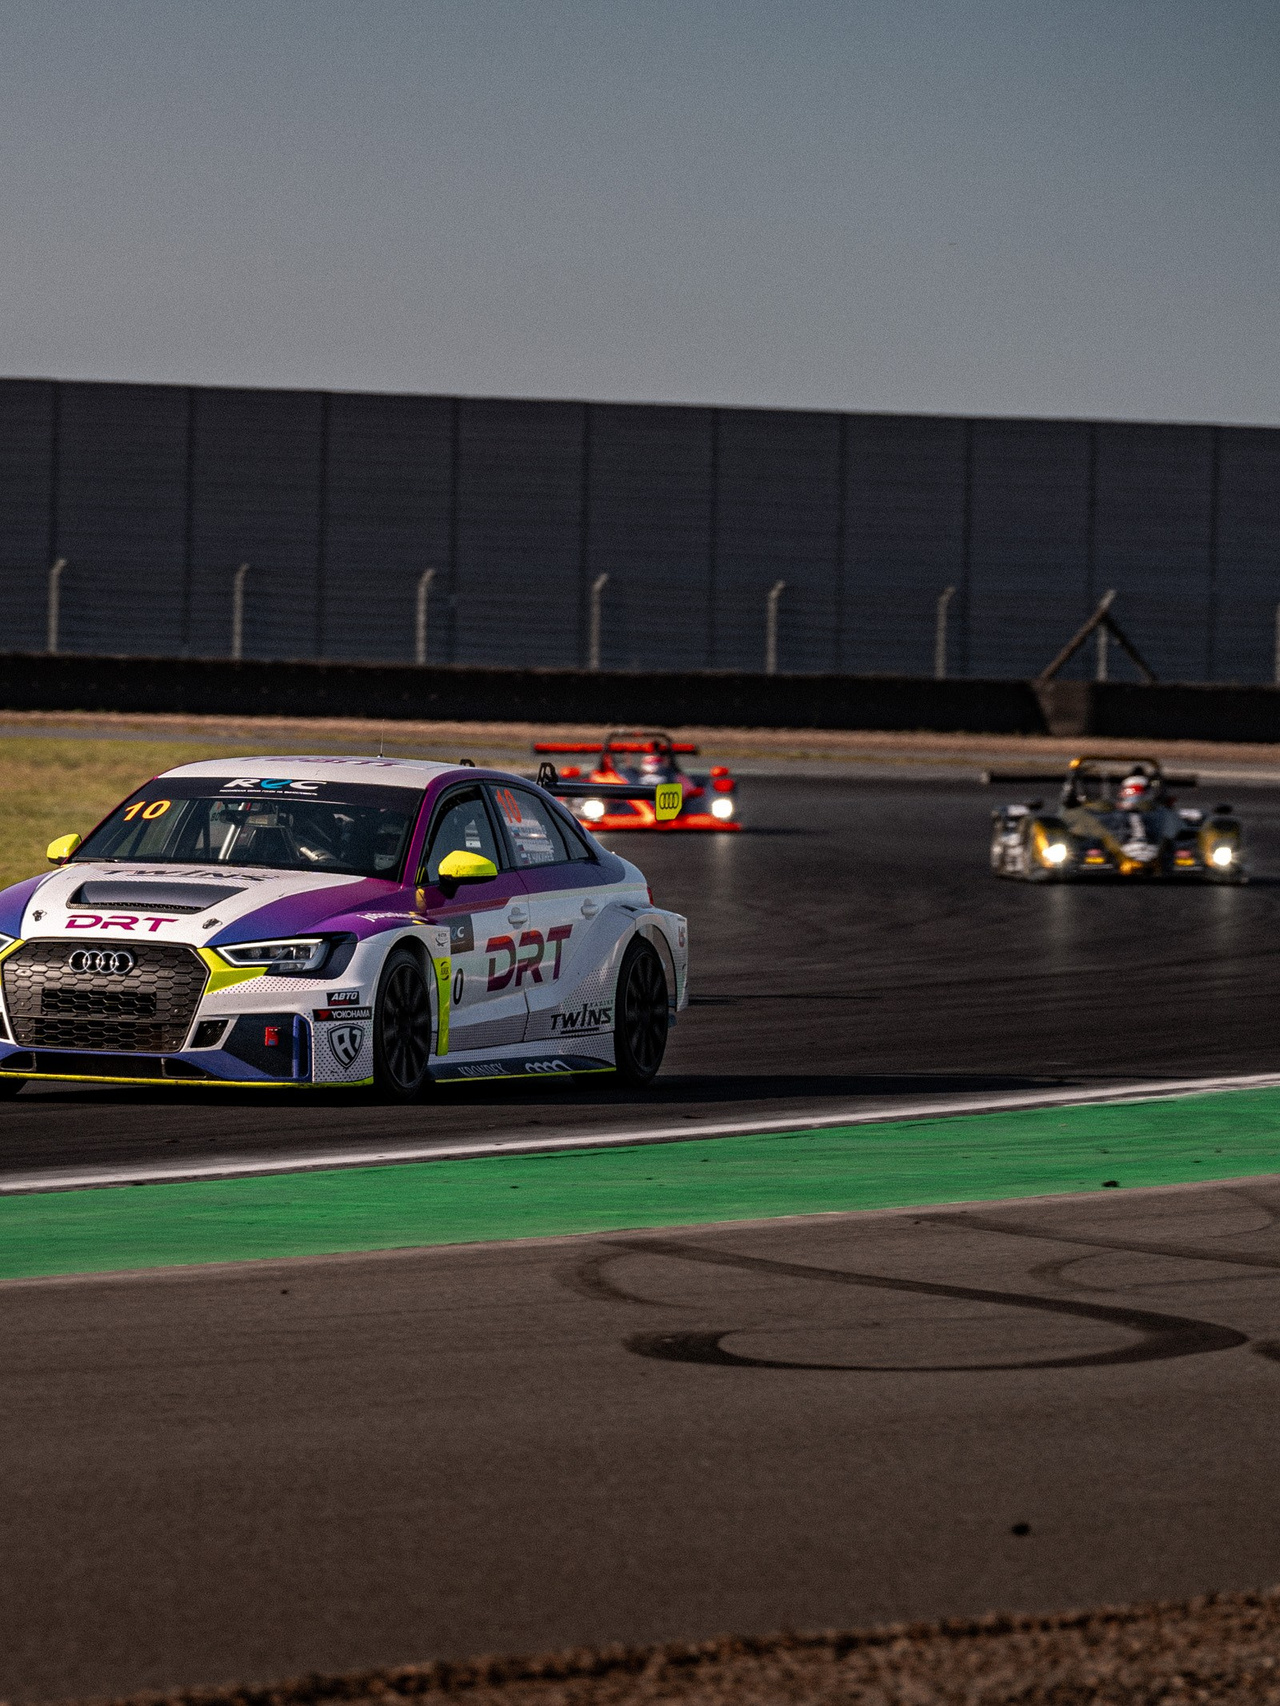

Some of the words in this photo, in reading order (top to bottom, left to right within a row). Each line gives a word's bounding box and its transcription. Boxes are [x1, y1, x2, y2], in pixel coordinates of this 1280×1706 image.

[123, 800, 171, 821] 10
[496, 788, 522, 823] 10
[65, 914, 179, 932] DRT
[485, 923, 574, 993] DRT
[331, 1010, 370, 1019] YOKOHAMA
[550, 1003, 613, 1030] TWINS
